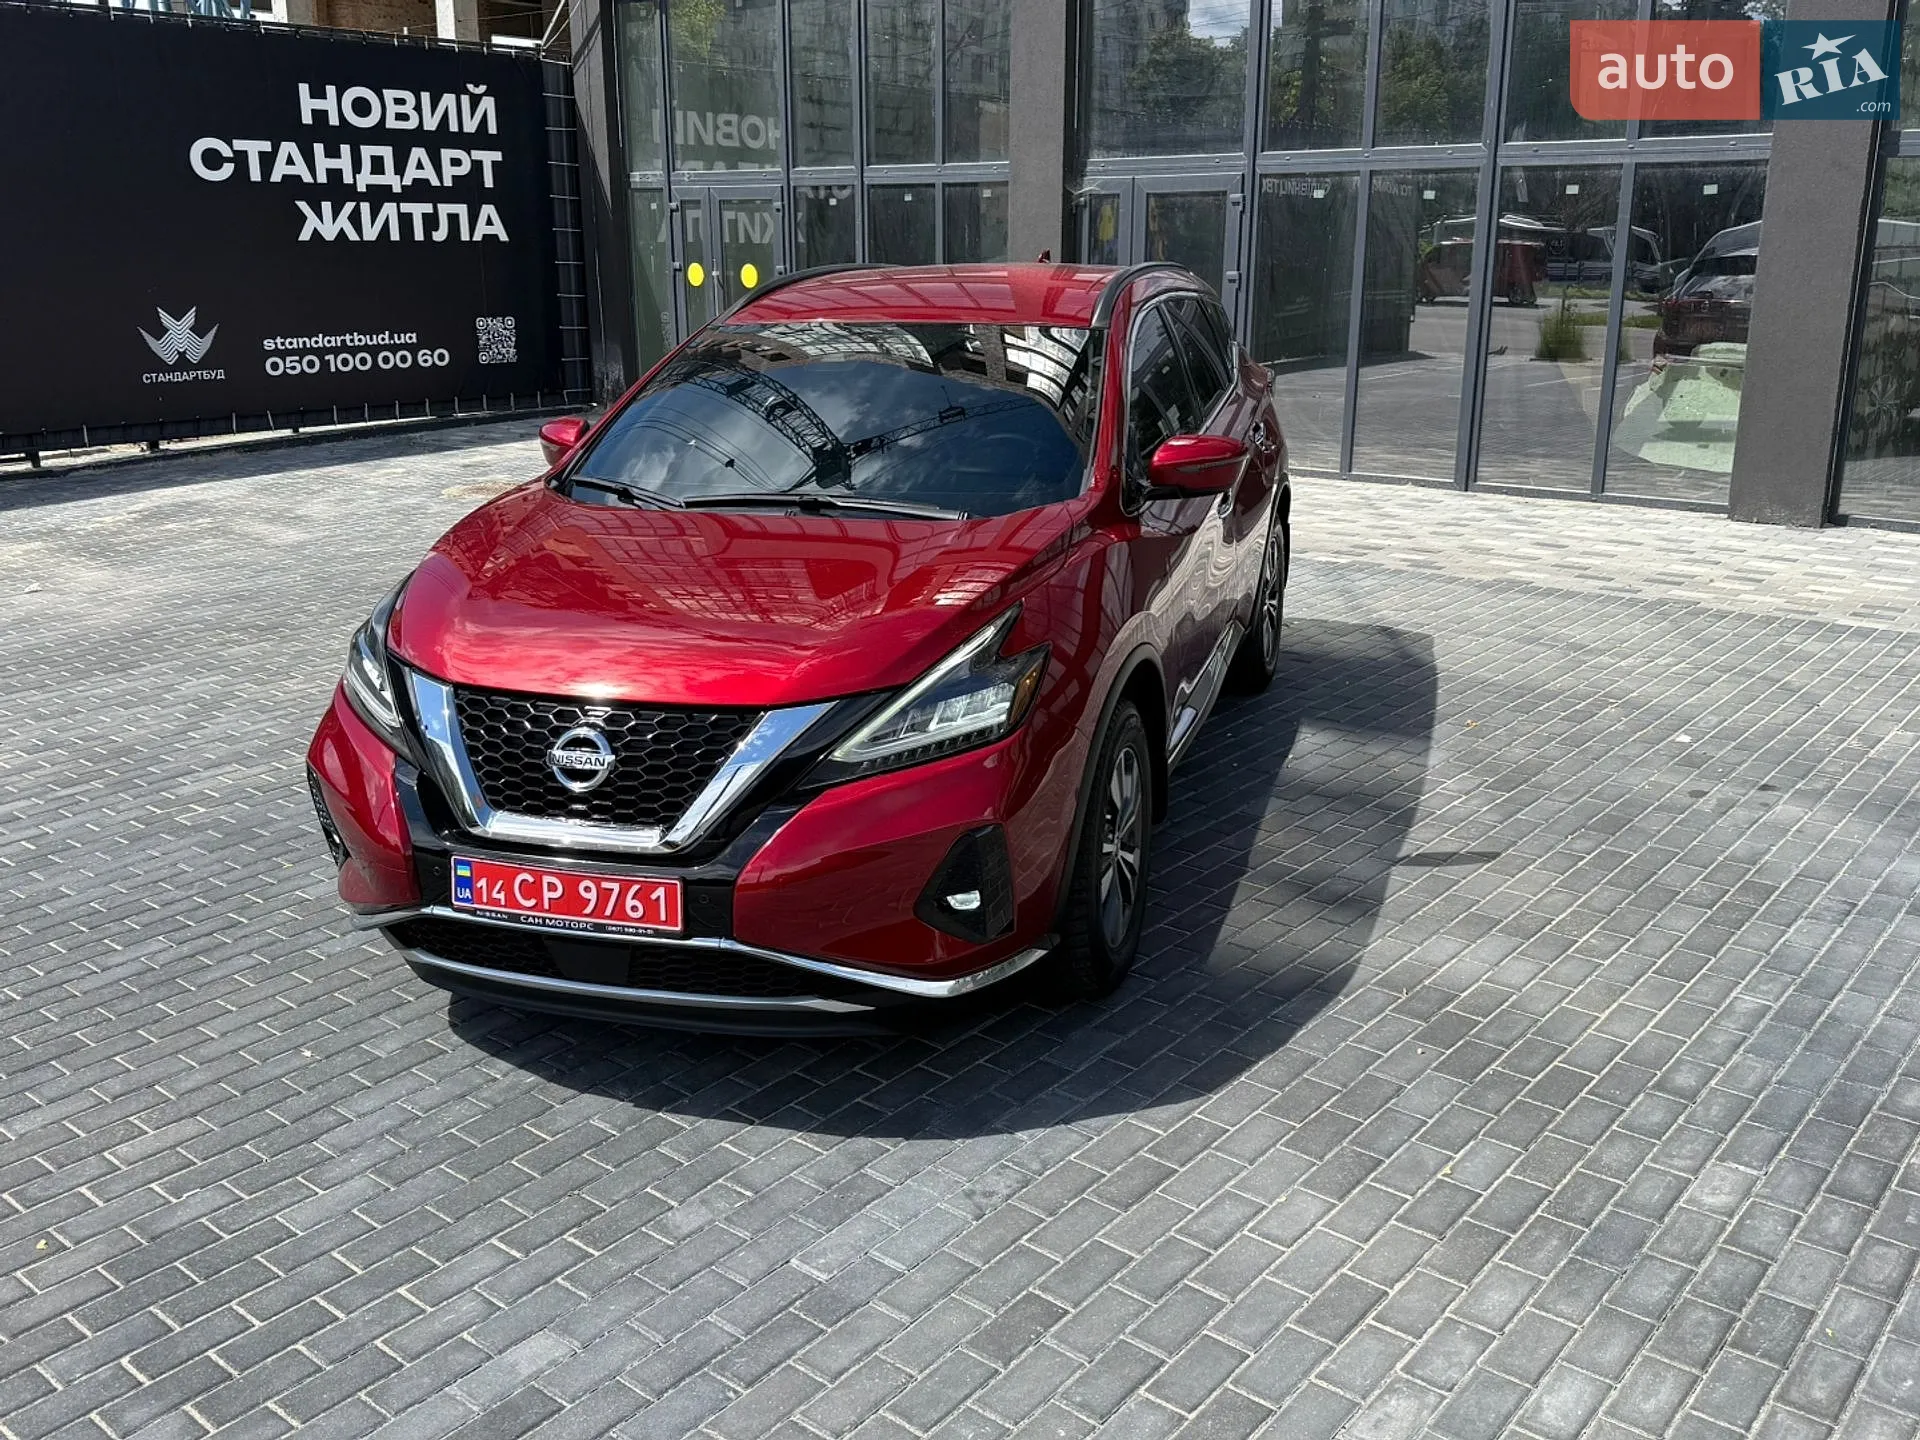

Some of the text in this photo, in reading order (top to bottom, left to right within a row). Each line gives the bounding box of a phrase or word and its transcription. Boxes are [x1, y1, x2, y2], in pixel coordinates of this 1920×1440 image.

[298, 83, 497, 134] НОВИЙ
[189, 137, 502, 193] СТАНДАРТ
[295, 200, 509, 242] ЖИТЛА
[262, 331, 417, 350] standartbud.ua
[265, 348, 450, 376] 050 100 00 60
[142, 369, 225, 383] СТАНДАРТБУД
[551, 754, 606, 768] NISSAN
[457, 887, 471, 900] UA
[578, 879, 668, 922] 9761
[520, 915, 543, 925] САН
[545, 918, 594, 931] МОТОРС
